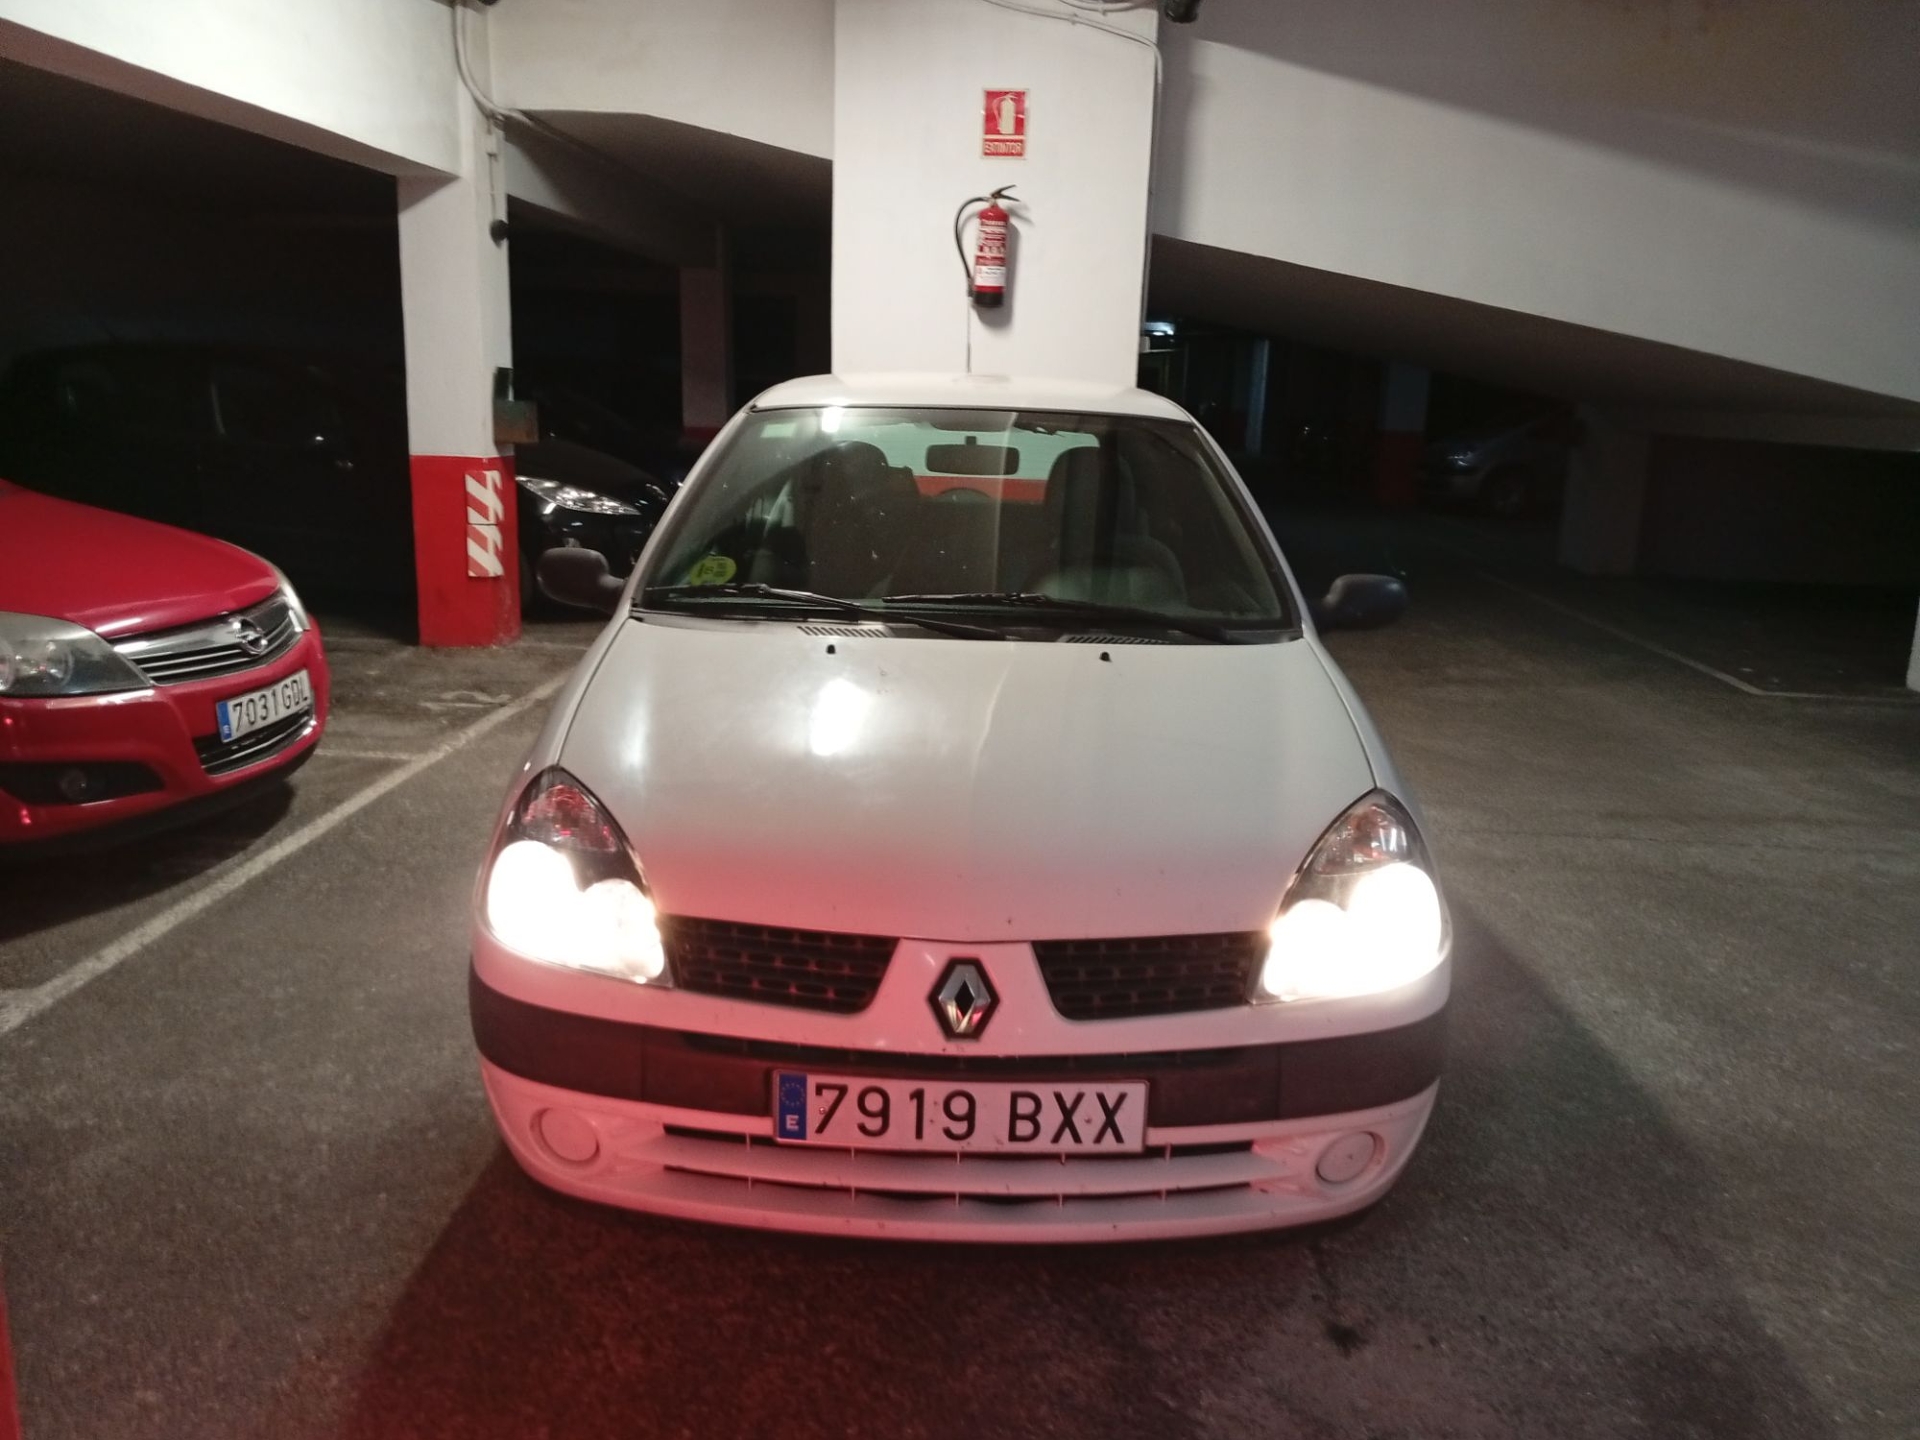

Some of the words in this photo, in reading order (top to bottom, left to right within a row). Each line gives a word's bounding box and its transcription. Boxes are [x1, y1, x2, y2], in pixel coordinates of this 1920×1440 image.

[232, 688, 278, 732] 7031
[785, 1115, 800, 1132] E
[814, 1083, 977, 1142] 7919
[1007, 1090, 1128, 1145] BXX
